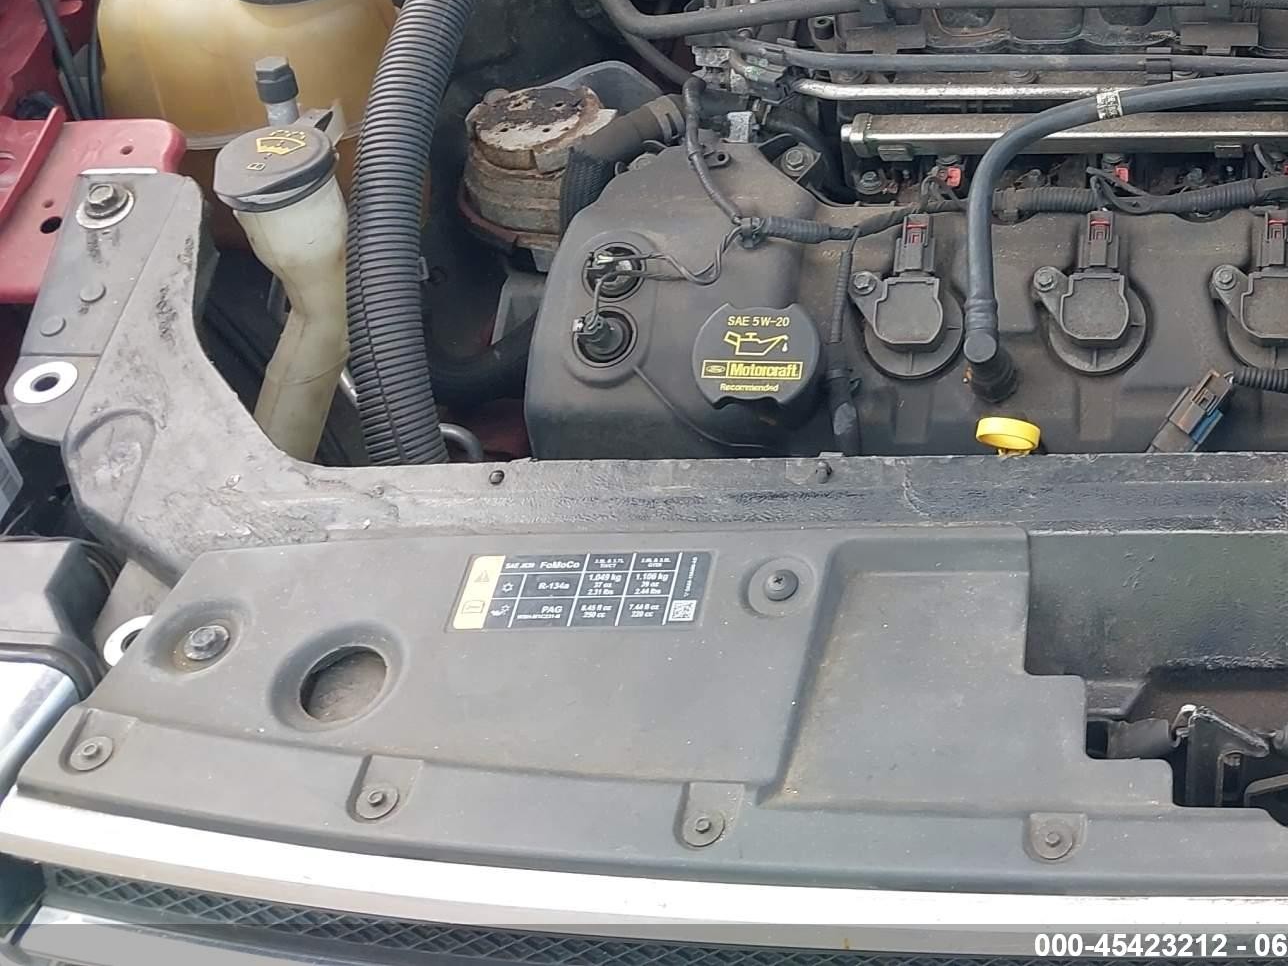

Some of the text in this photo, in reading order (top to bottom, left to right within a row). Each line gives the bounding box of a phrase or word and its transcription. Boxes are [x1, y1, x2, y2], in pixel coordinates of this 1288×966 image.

[727, 316, 790, 326] SAE 5W-20
[730, 363, 798, 377] Motorcraft
[720, 383, 779, 392] Recommended
[539, 560, 581, 569] FoMoCo
[610, 574, 622, 582] kg
[659, 573, 669, 581] kg
[537, 582, 570, 590] R-134a
[541, 605, 563, 614] PAG
